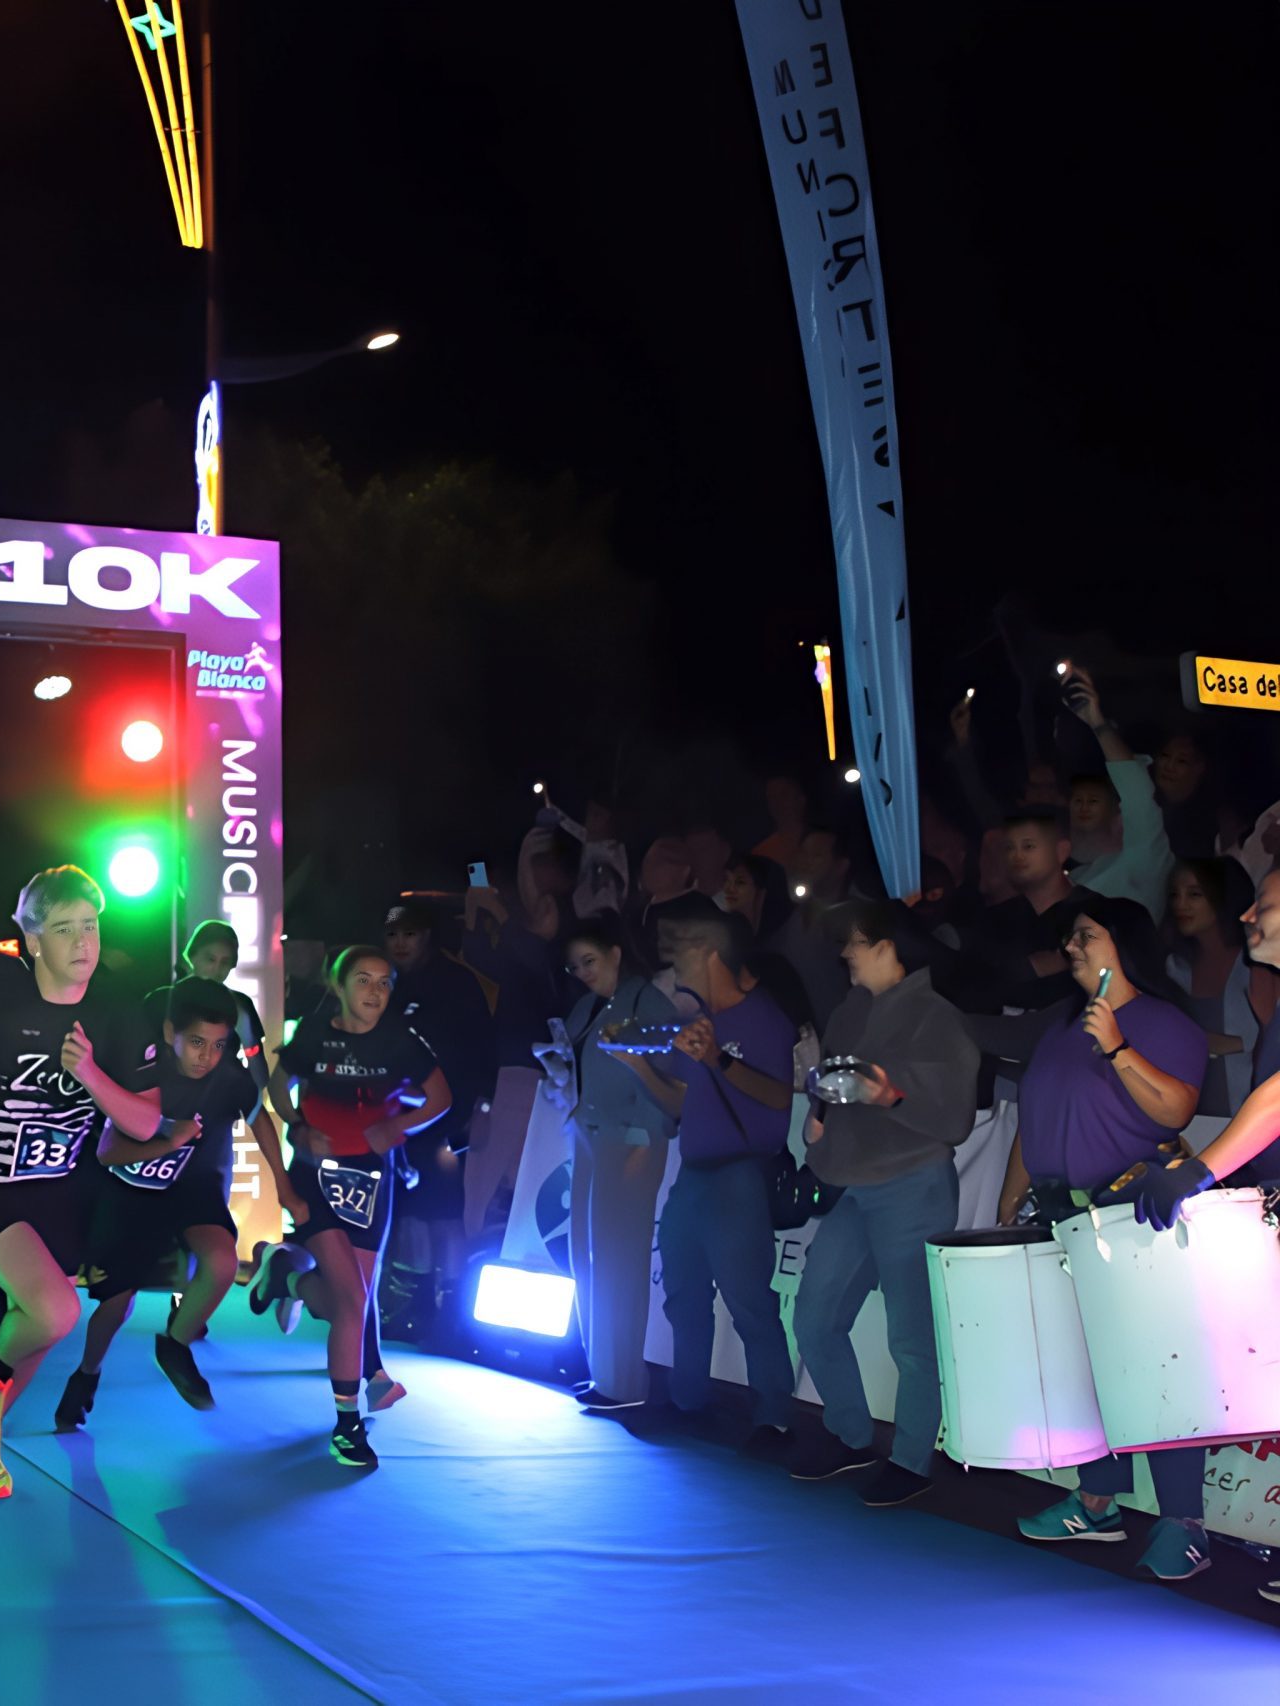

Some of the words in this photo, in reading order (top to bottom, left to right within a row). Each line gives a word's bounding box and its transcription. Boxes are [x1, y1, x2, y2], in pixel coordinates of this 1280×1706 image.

[187, 649, 244, 673] Playa
[197, 669, 266, 691] Blanca
[1203, 666, 1248, 694] Casa
[222, 739, 258, 895] MUSIC
